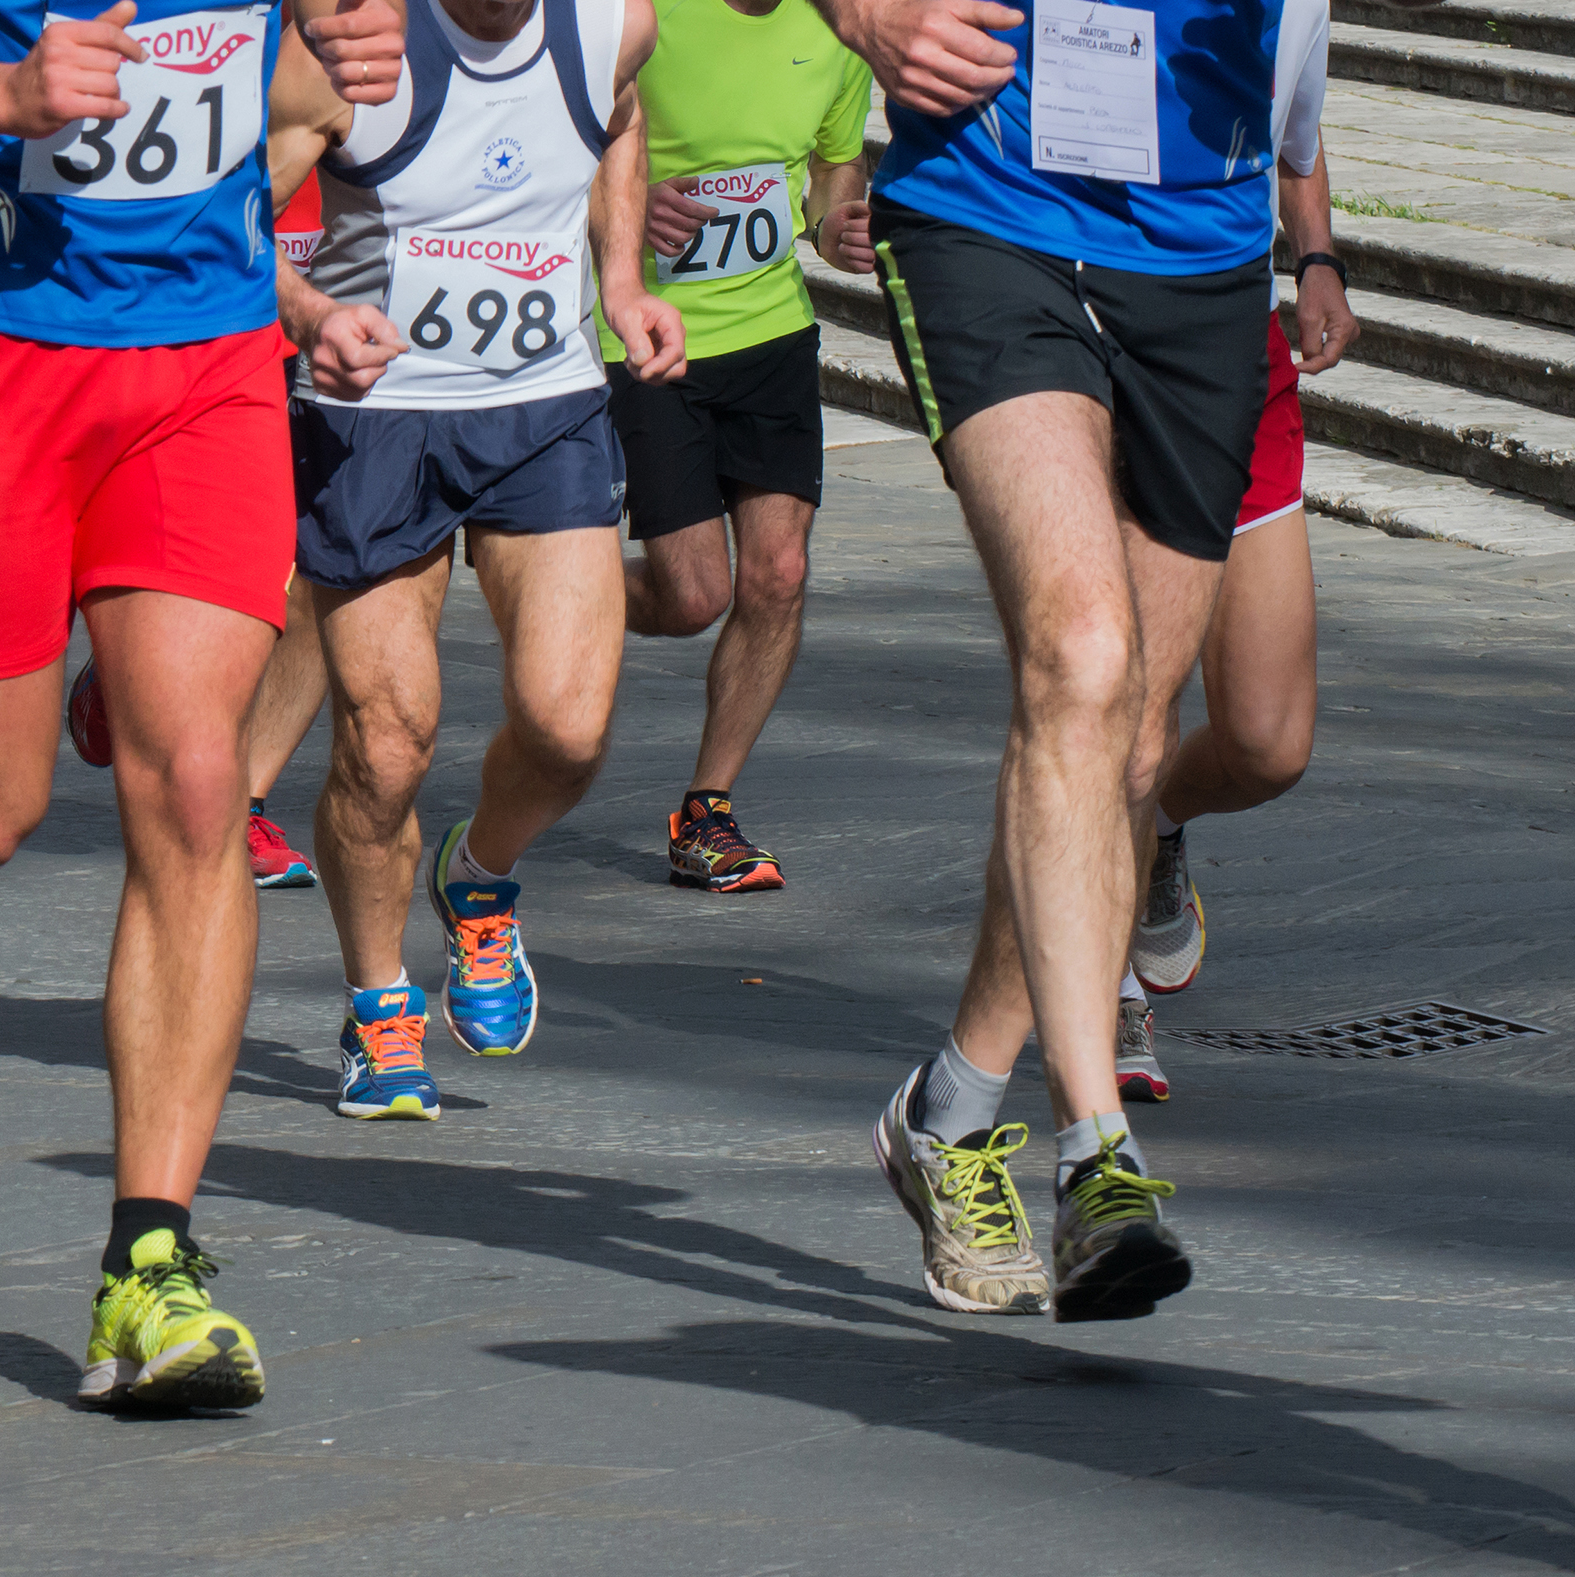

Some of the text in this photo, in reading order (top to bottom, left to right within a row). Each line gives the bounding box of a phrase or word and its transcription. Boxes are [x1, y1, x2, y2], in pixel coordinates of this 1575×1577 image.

[1061, 34, 1128, 55] PODISTICA AREZZO
[1078, 25, 1110, 40] AMATORI
[52, 84, 224, 185] 361
[407, 236, 541, 267] saucony
[671, 208, 779, 274] 270
[409, 286, 557, 359] 698
